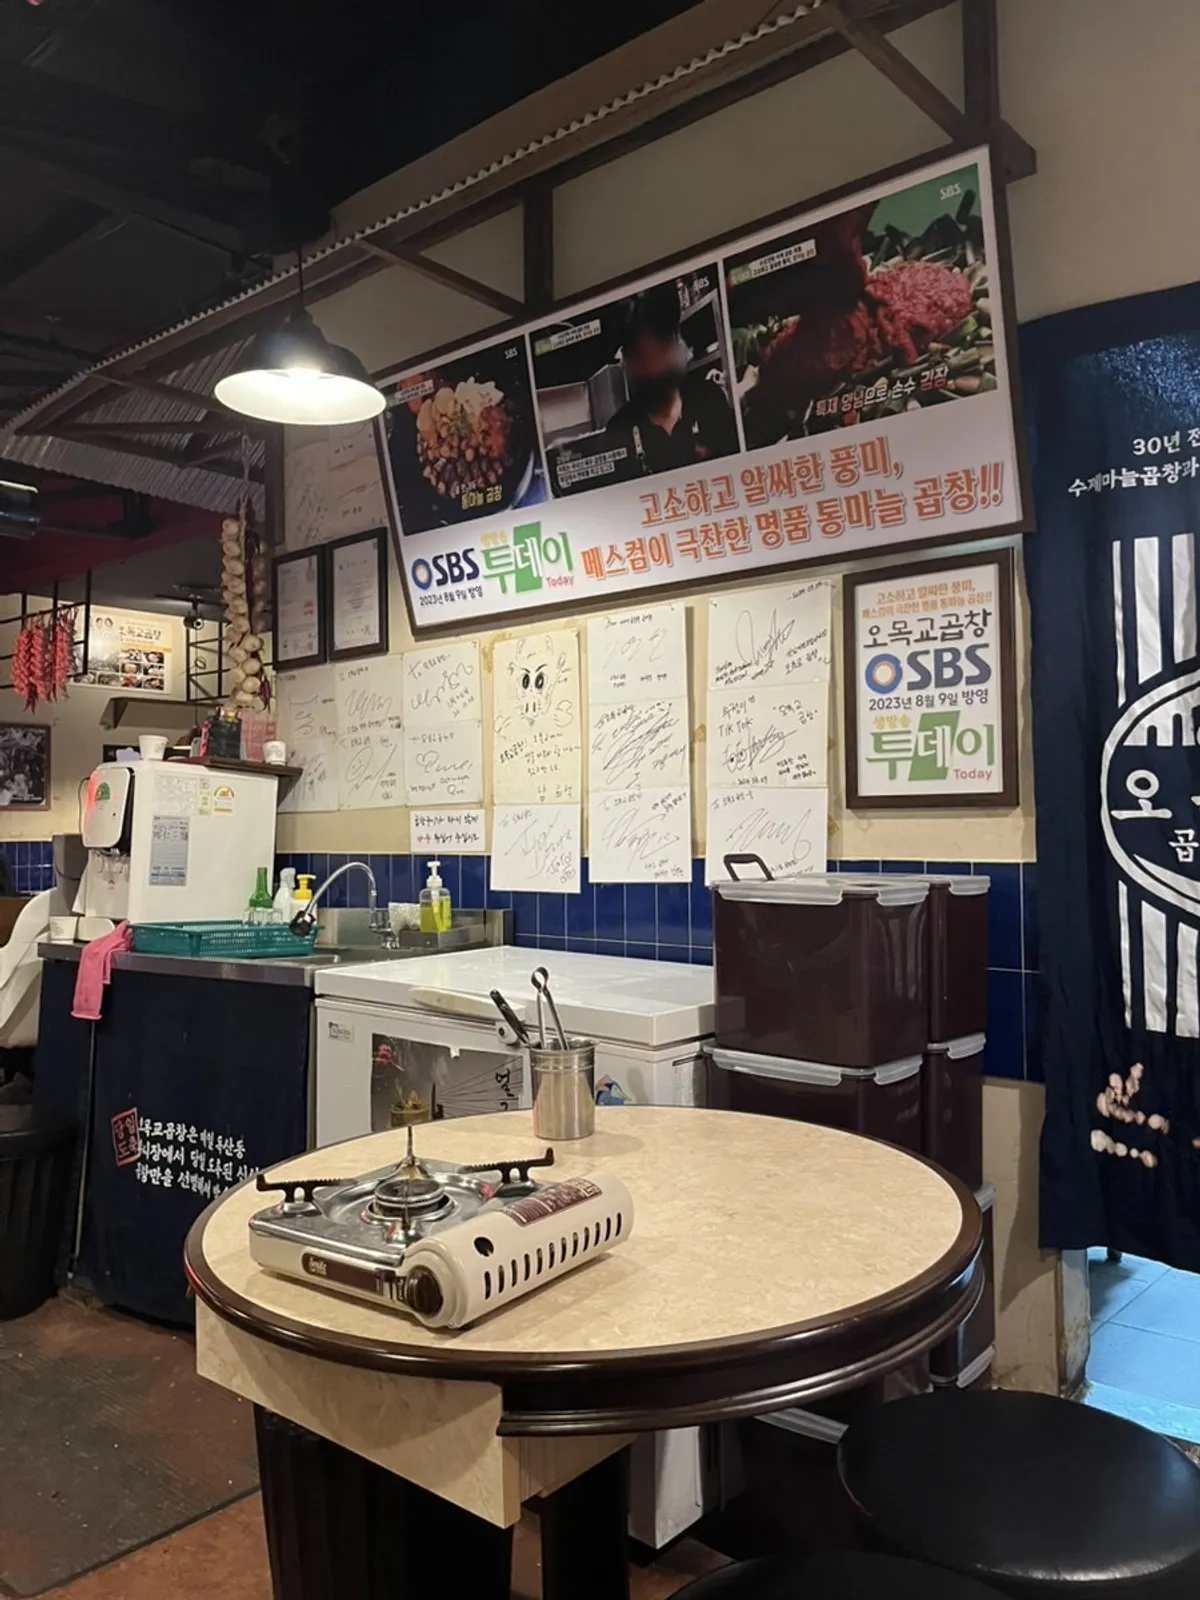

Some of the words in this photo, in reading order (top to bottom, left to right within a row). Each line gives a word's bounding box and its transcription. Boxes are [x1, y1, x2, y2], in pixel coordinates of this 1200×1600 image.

[940, 182, 961, 200] SBS
[504, 347, 519, 360] SBS
[891, 376, 916, 399] 손수
[1132, 430, 1180, 456] 30년
[639, 473, 737, 527] 고소하고
[740, 452, 824, 505] 알싸한
[830, 436, 904, 487] 풍미,
[675, 516, 752, 562] 극찬한
[755, 505, 811, 550] 명품
[816, 489, 907, 538] 통마늘
[912, 460, 1004, 521] 곱창!!
[432, 548, 480, 587] SBS
[480, 531, 574, 594] 투데이
[545, 574, 574, 589] Today
[863, 608, 992, 648] 오목교곱창
[907, 643, 992, 691] SBS
[869, 696, 912, 710] 2023년
[915, 694, 935, 708] 8월
[938, 692, 958, 706] 9일
[961, 688, 989, 705] 방영
[865, 723, 995, 781] 투데이
[953, 768, 993, 782] Today
